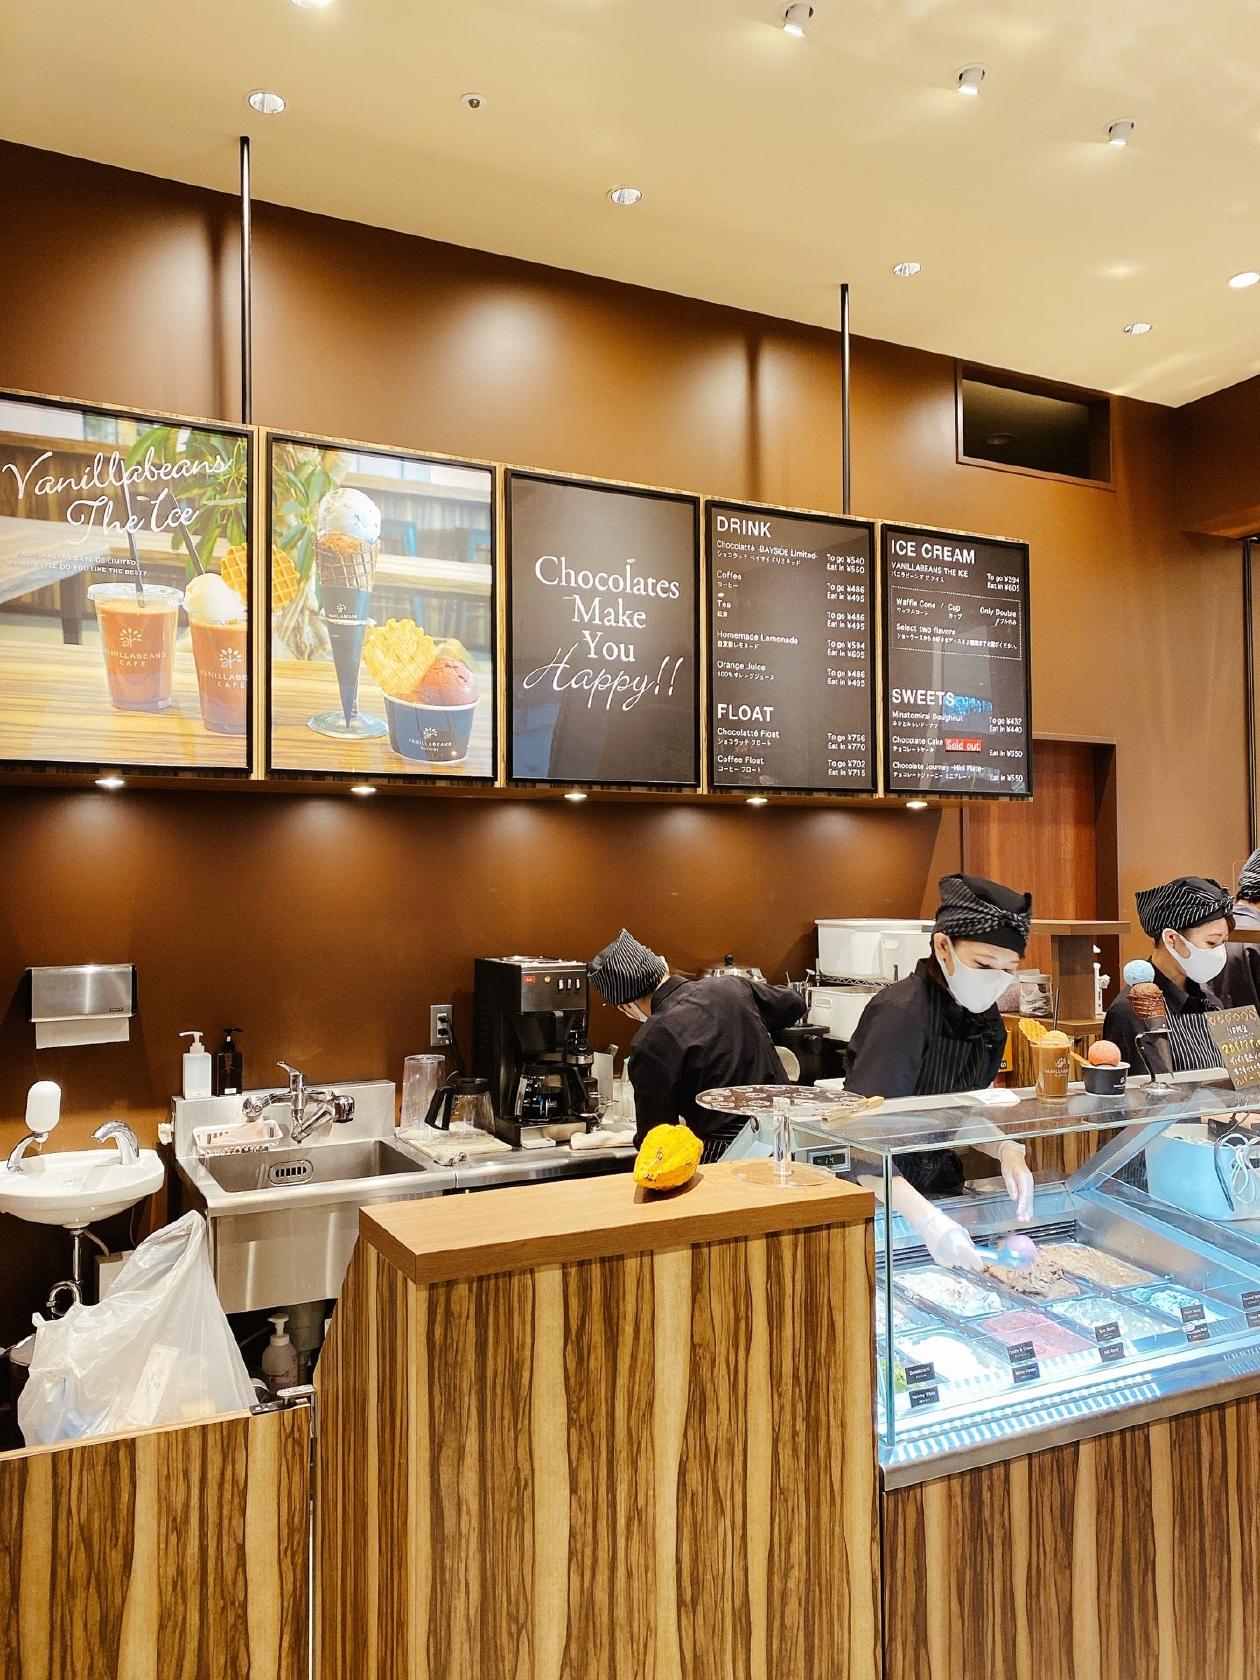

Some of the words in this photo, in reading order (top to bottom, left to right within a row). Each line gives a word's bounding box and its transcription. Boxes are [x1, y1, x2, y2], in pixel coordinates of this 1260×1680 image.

[2, 447, 233, 499] Vanillabeans
[66, 495, 146, 546] The
[150, 487, 199, 533] Ice
[717, 515, 772, 538] DRINK
[891, 539, 917, 557] ICE
[921, 543, 975, 565] CREAM
[74, 555, 105, 563] BAYSIDE
[826, 553, 835, 562] To
[835, 556, 845, 564] go
[846, 556, 865, 565] ¥540
[826, 563, 838, 571] Eat
[838, 564, 845, 572] in
[891, 561, 942, 574] VANILLABEANS
[943, 567, 957, 576] THE
[958, 569, 969, 578] ICE
[534, 555, 681, 599] Chocolates
[716, 570, 742, 581] Coffee
[986, 572, 995, 581] To
[995, 575, 1004, 583] go
[717, 581, 739, 589] コーヒー
[826, 582, 835, 591] To
[835, 585, 845, 593] go
[987, 581, 997, 590] Eat
[826, 592, 838, 600] Eat
[717, 600, 732, 609] Tea
[896, 597, 918, 607] Waffle
[919, 600, 936, 609] Cone
[948, 603, 961, 613] Cup
[571, 594, 647, 629] Make
[826, 611, 835, 620] To
[836, 613, 845, 621] go
[979, 606, 994, 617] Only
[995, 608, 1017, 618] Double
[827, 620, 838, 628] Eat
[896, 622, 917, 632] Select
[919, 625, 932, 633] two
[933, 626, 956, 636] flavors
[717, 630, 759, 641] Homemade
[760, 633, 799, 645] Lemonade
[581, 630, 636, 662] You
[826, 639, 835, 648] To
[836, 641, 845, 650] go
[119, 660, 147, 668] CAFE
[717, 660, 745, 671] Orange
[746, 662, 766, 672] Juice
[522, 642, 684, 711] Happy!!
[827, 668, 836, 677] To
[836, 670, 845, 678] go
[827, 677, 838, 685] Eat
[839, 678, 846, 686] in
[892, 688, 955, 706] SWEETS
[717, 703, 774, 722] FLOAT
[892, 711, 931, 721] Minatomirai
[932, 713, 964, 723] Doughnut
[989, 717, 997, 725] To
[997, 718, 1005, 726] go
[760, 729, 780, 739] Float
[989, 724, 999, 733] Eat
[827, 732, 836, 741] To
[836, 734, 846, 742] go
[892, 735, 926, 746] Chocolate
[927, 737, 944, 746] Cake
[751, 739, 772, 747] フロート
[828, 742, 838, 750] Eat
[839, 742, 846, 750] in
[946, 739, 964, 751] Sold
[966, 741, 981, 751] out
[989, 749, 998, 757] Eat
[717, 755, 743, 764] Coffee
[744, 756, 765, 765] Float
[828, 759, 836, 768] To
[836, 761, 846, 769] go
[847, 760, 866, 768] ¥702
[741, 766, 761, 774] フロート
[892, 761, 924, 770] Chocolate
[925, 763, 950, 772] Journey
[828, 768, 838, 776] Eat
[847, 768, 866, 777] ¥715
[989, 773, 999, 782] Eat
[999, 774, 1005, 782] in
